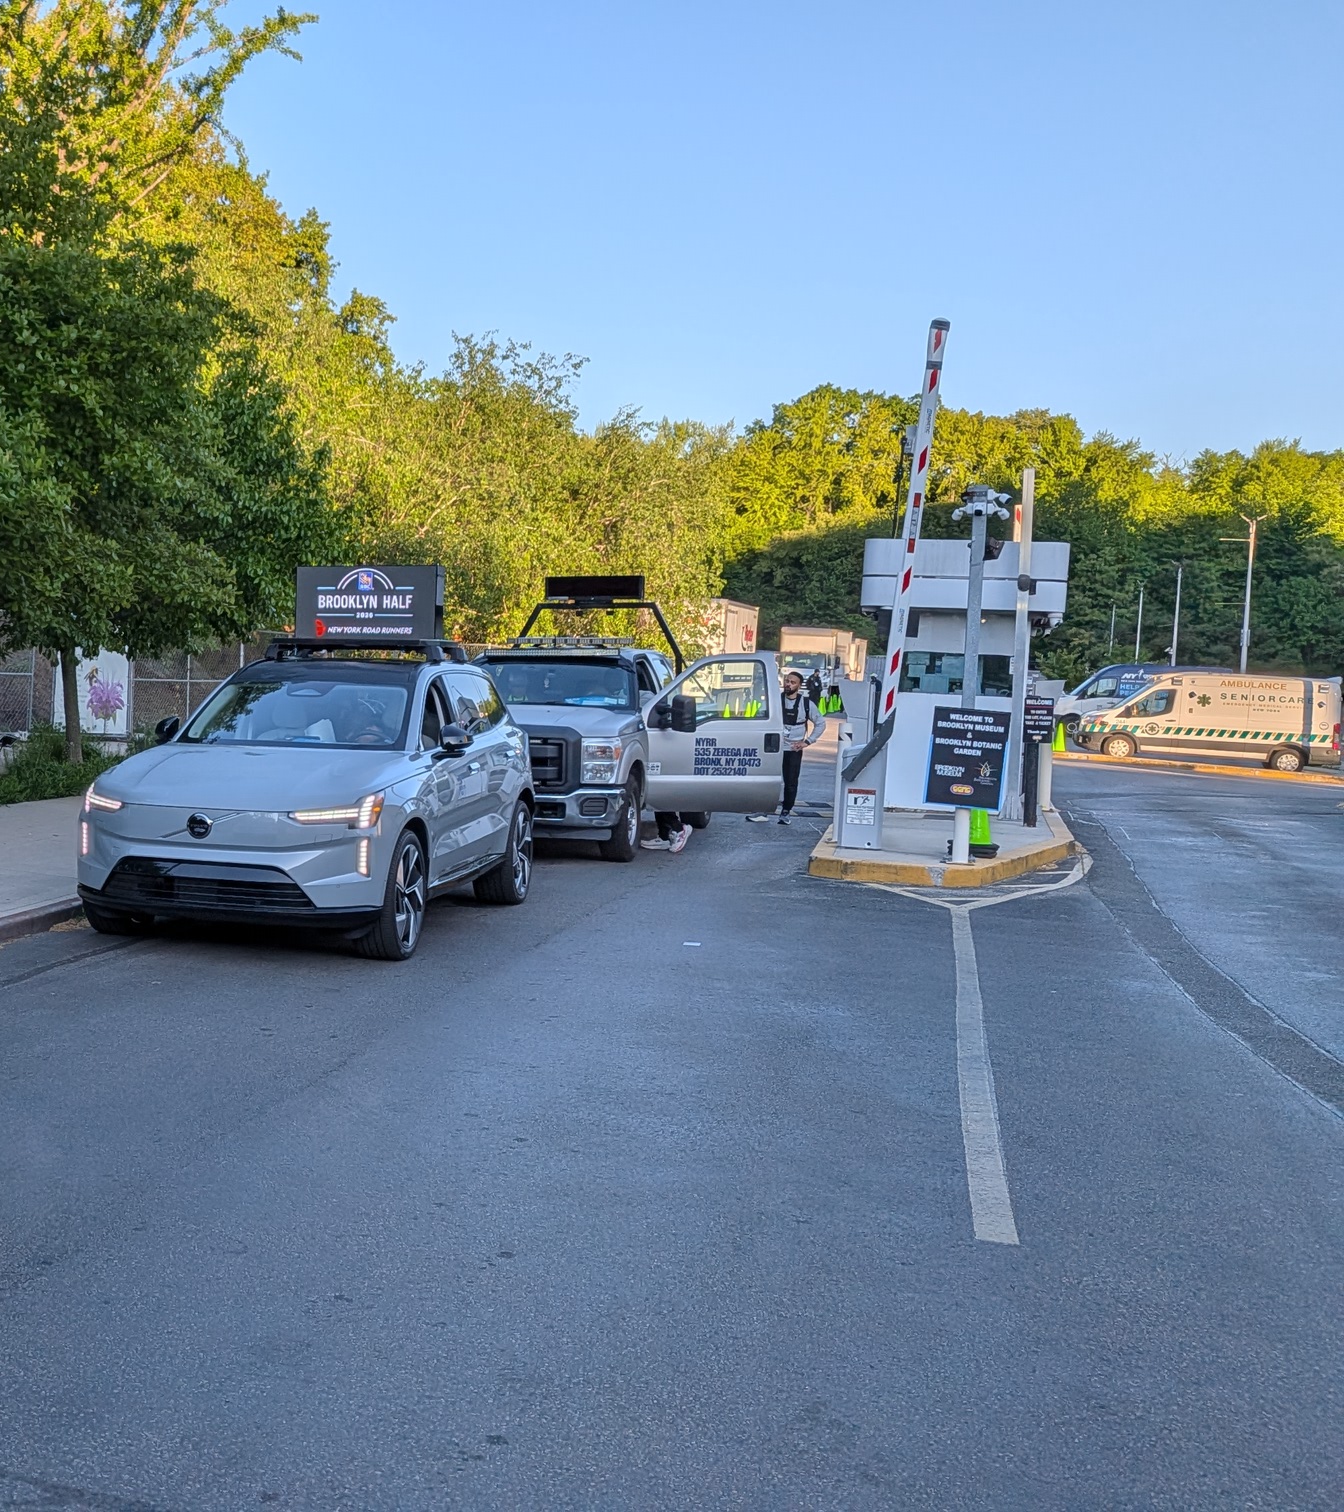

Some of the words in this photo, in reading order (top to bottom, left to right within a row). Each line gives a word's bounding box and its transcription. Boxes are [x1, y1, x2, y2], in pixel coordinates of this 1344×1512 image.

[318, 595, 377, 609] BROOKLYN
[383, 595, 413, 609] HALF
[381, 627, 413, 635] RUNNERS
[1220, 680, 1287, 690] AMBULANCE
[1220, 693, 1314, 705] SENIORCARE
[950, 713, 983, 722] WELCOME
[937, 721, 973, 730] BROOKLYN
[975, 724, 1005, 733] MUSEUM
[695, 738, 717, 747] NYRR
[935, 738, 971, 747] BROOKLYN
[972, 741, 1003, 750] BOTANIC
[694, 748, 711, 757] 535
[712, 748, 741, 757] ZEREGA
[742, 748, 758, 757] AVE
[953, 748, 982, 756] GARDEN
[725, 758, 736, 767] NY
[737, 758, 761, 767] 10473
[693, 767, 710, 775] DOT
[711, 767, 747, 776] 2532140
